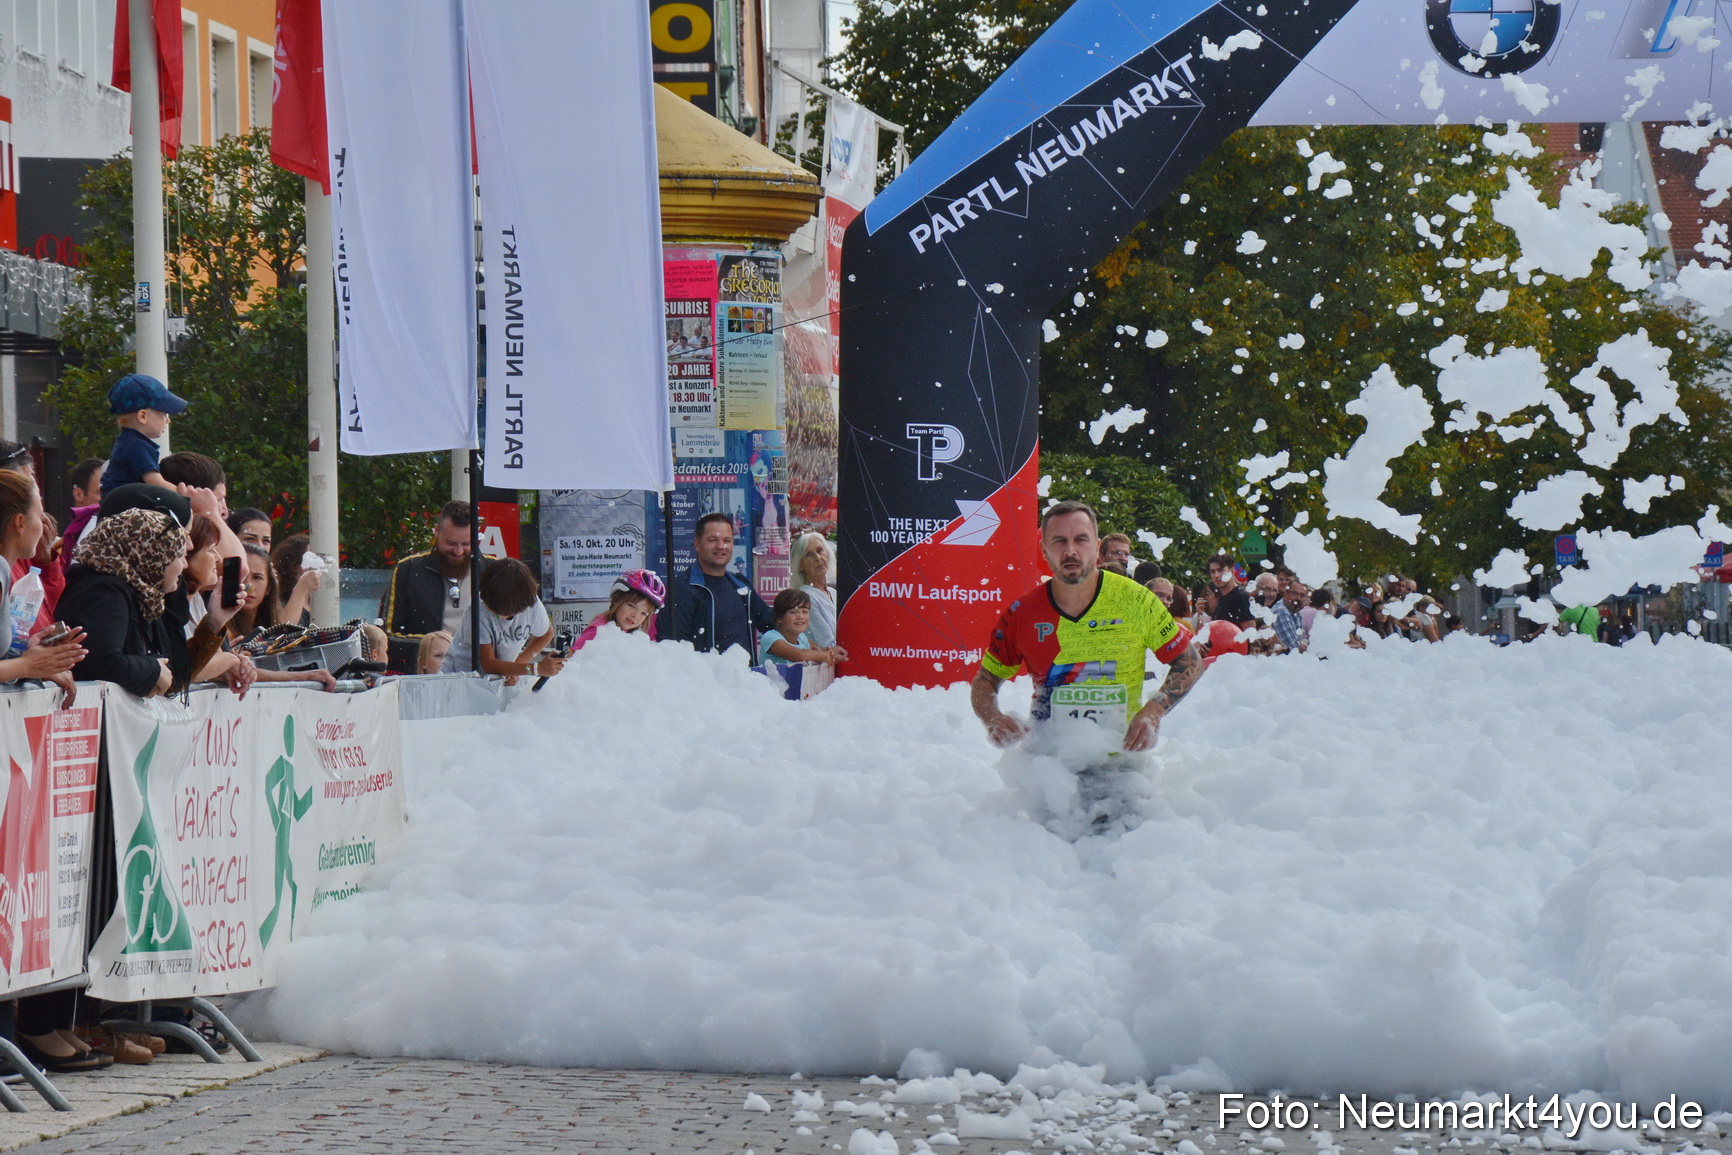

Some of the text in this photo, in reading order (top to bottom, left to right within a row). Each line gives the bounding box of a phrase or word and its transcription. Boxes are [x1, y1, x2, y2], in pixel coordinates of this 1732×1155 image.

[908, 52, 1200, 254] PARTL NEUMARKT
[665, 301, 709, 315] SUNRISE
[717, 318, 725, 360] Sukkulenten
[681, 364, 711, 376] JAHRE
[684, 381, 711, 390] Konzert
[673, 391, 711, 402] 18.30 Uhr
[678, 404, 711, 413] Neumarkt
[673, 462, 749, 475] edankfest 2019
[888, 518, 949, 532] THE NEXT
[560, 538, 634, 548] Sa. 19. Okt. 20 Uhr
[870, 531, 933, 544] 100 YEARS
[1558, 555, 1575, 563] TAXI
[869, 582, 1002, 604] BMW Laufsport
[561, 610, 583, 622] JAHRE
[1058, 688, 1120, 703] BOCK
[207, 716, 242, 767] UNS
